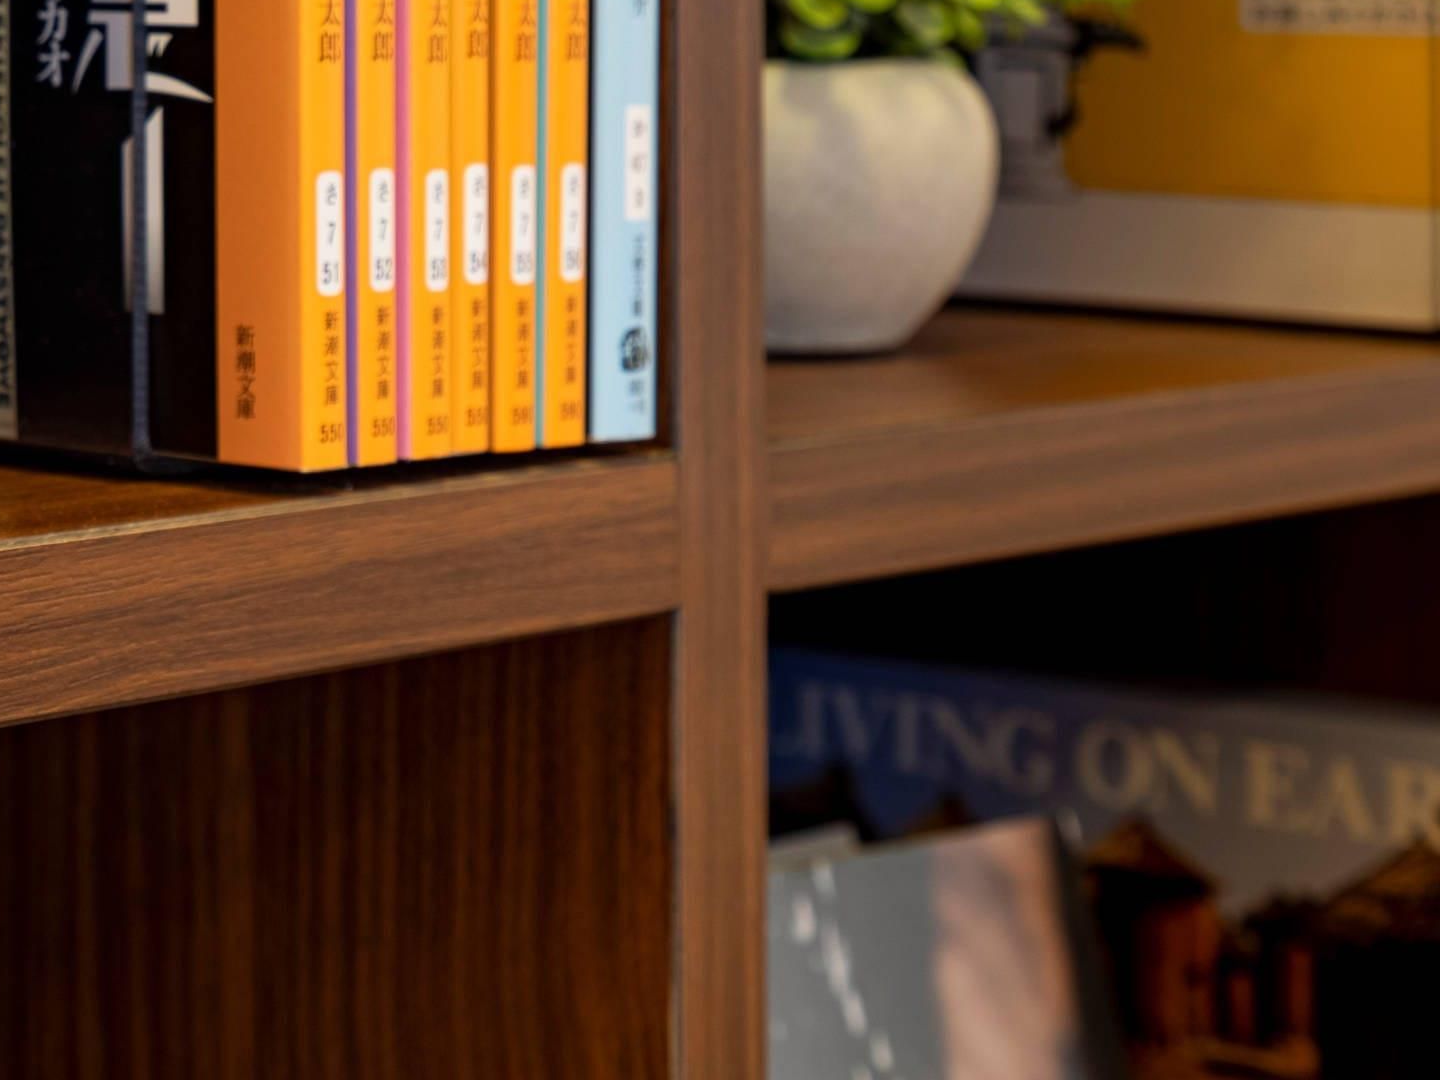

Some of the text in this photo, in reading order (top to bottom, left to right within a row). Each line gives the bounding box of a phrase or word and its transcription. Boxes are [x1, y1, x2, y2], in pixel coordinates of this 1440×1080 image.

[234, 323, 256, 421] 新潮文庫
[1076, 717, 1222, 818] ON
